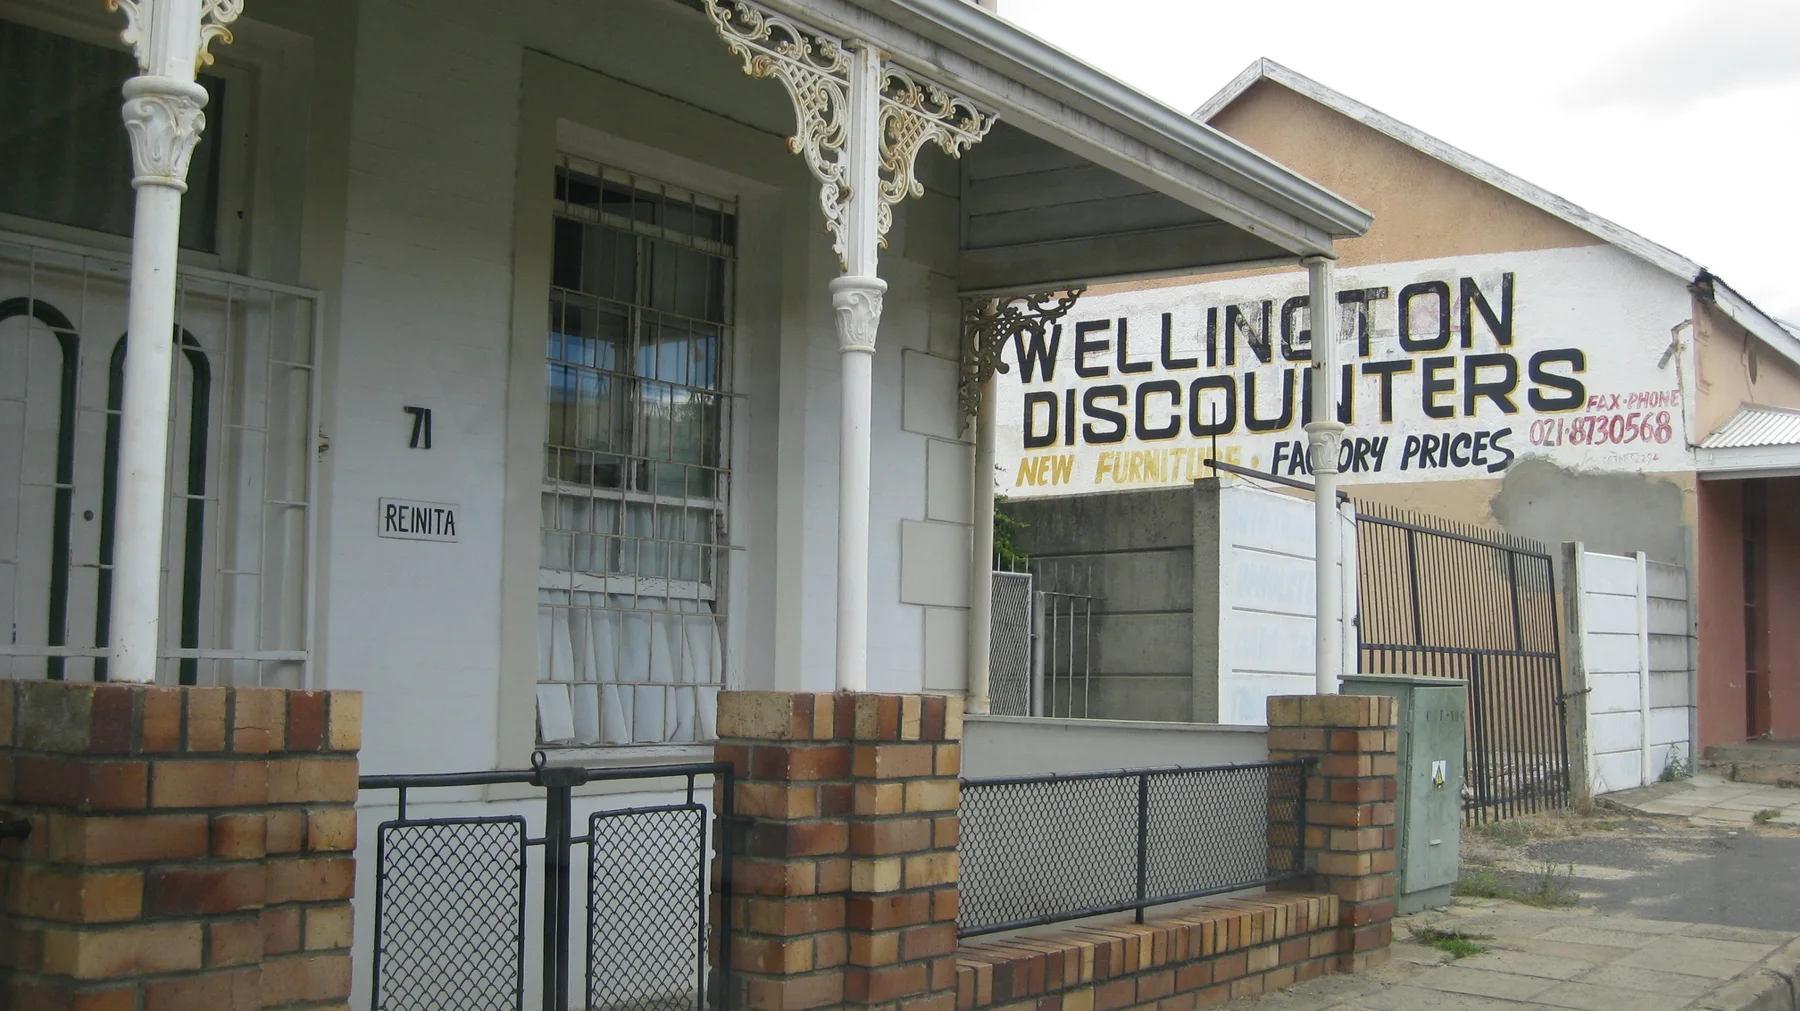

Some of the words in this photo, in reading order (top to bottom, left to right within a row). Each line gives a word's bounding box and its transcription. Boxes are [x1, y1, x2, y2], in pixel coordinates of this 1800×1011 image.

[1014, 271, 1514, 384] WELLINGTON
[404, 406, 431, 449] 71
[1023, 348, 1585, 449] DISCOUNTERS
[1015, 454, 1075, 487] NEW
[1271, 436, 1389, 476] FAORY
[1400, 427, 1514, 474] PRICES
[385, 504, 455, 536] REINITA
